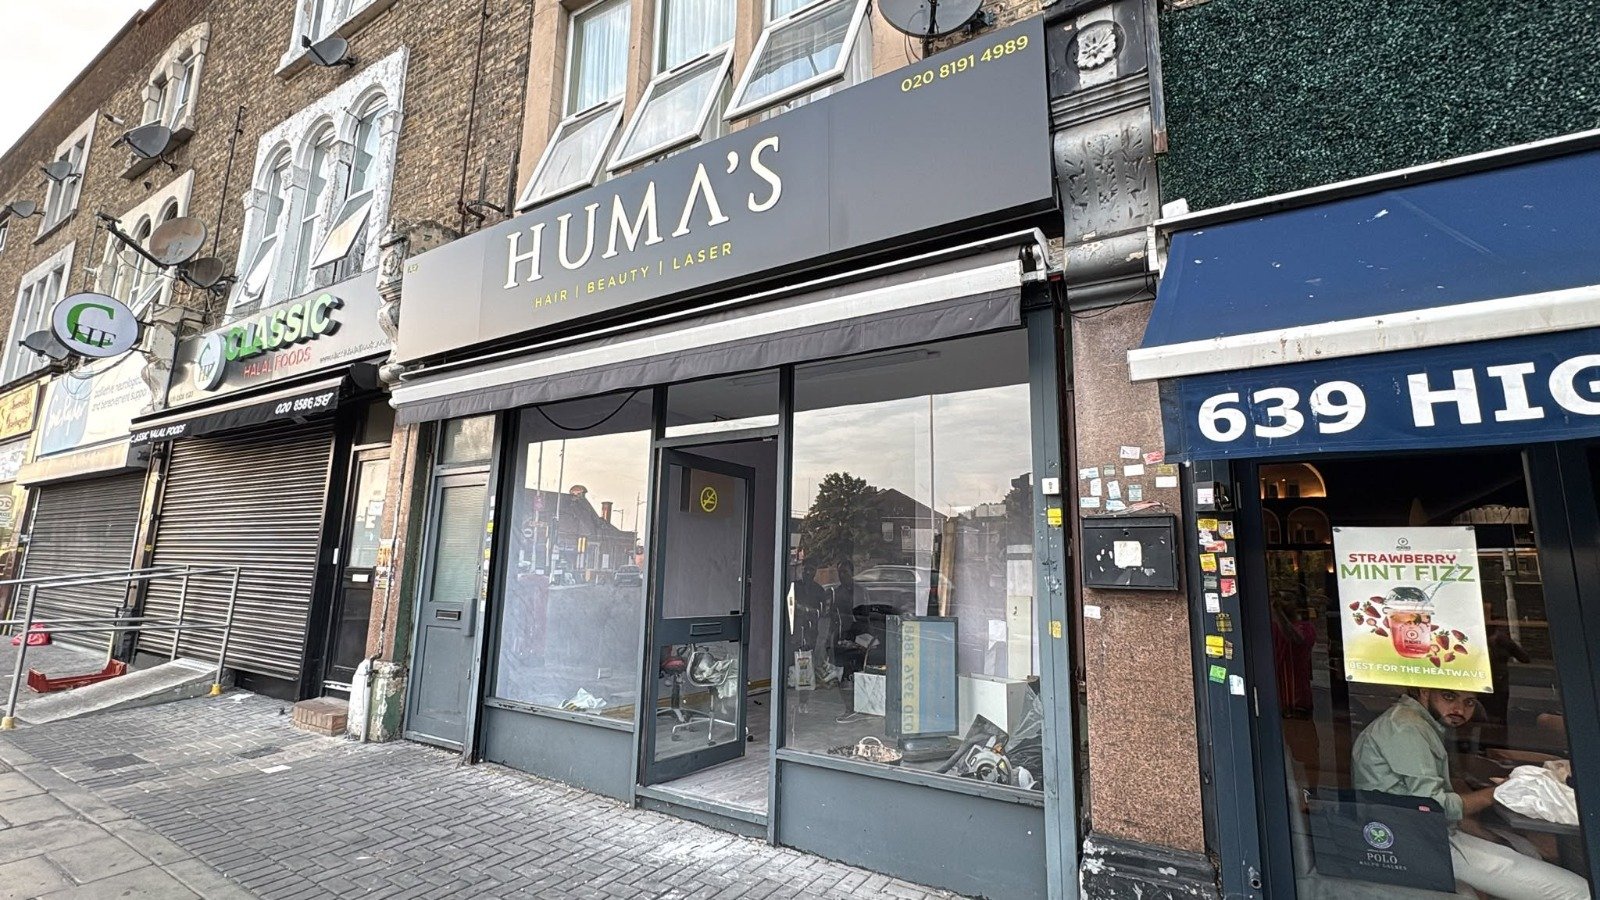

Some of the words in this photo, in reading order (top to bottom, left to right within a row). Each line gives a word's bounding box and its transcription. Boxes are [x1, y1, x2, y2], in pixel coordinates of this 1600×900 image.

[901, 70, 934, 92] 020
[939, 54, 975, 79] 8191
[980, 35, 1029, 63] 4989
[503, 135, 783, 290] HUMA'S
[534, 289, 568, 309] HAIR
[587, 265, 650, 294] BEAUTY
[673, 242, 732, 271] LASER
[226, 293, 338, 361] CLASSIC
[244, 360, 272, 378] HALAL
[275, 346, 311, 371] FOODS
[275, 401, 293, 415] 020
[1198, 380, 1367, 443] 639
[1407, 353, 1600, 428] HIG
[1341, 564, 1406, 581] MINT
[1415, 565, 1476, 582] FIZZ
[1349, 553, 1457, 564] STRAWBERRY
[1349, 661, 1374, 670] BEST
[1375, 663, 1398, 672] FOR
[1400, 665, 1420, 674] THE
[1422, 666, 1487, 679] HEATWAVE
[1367, 853, 1398, 864] POLO
